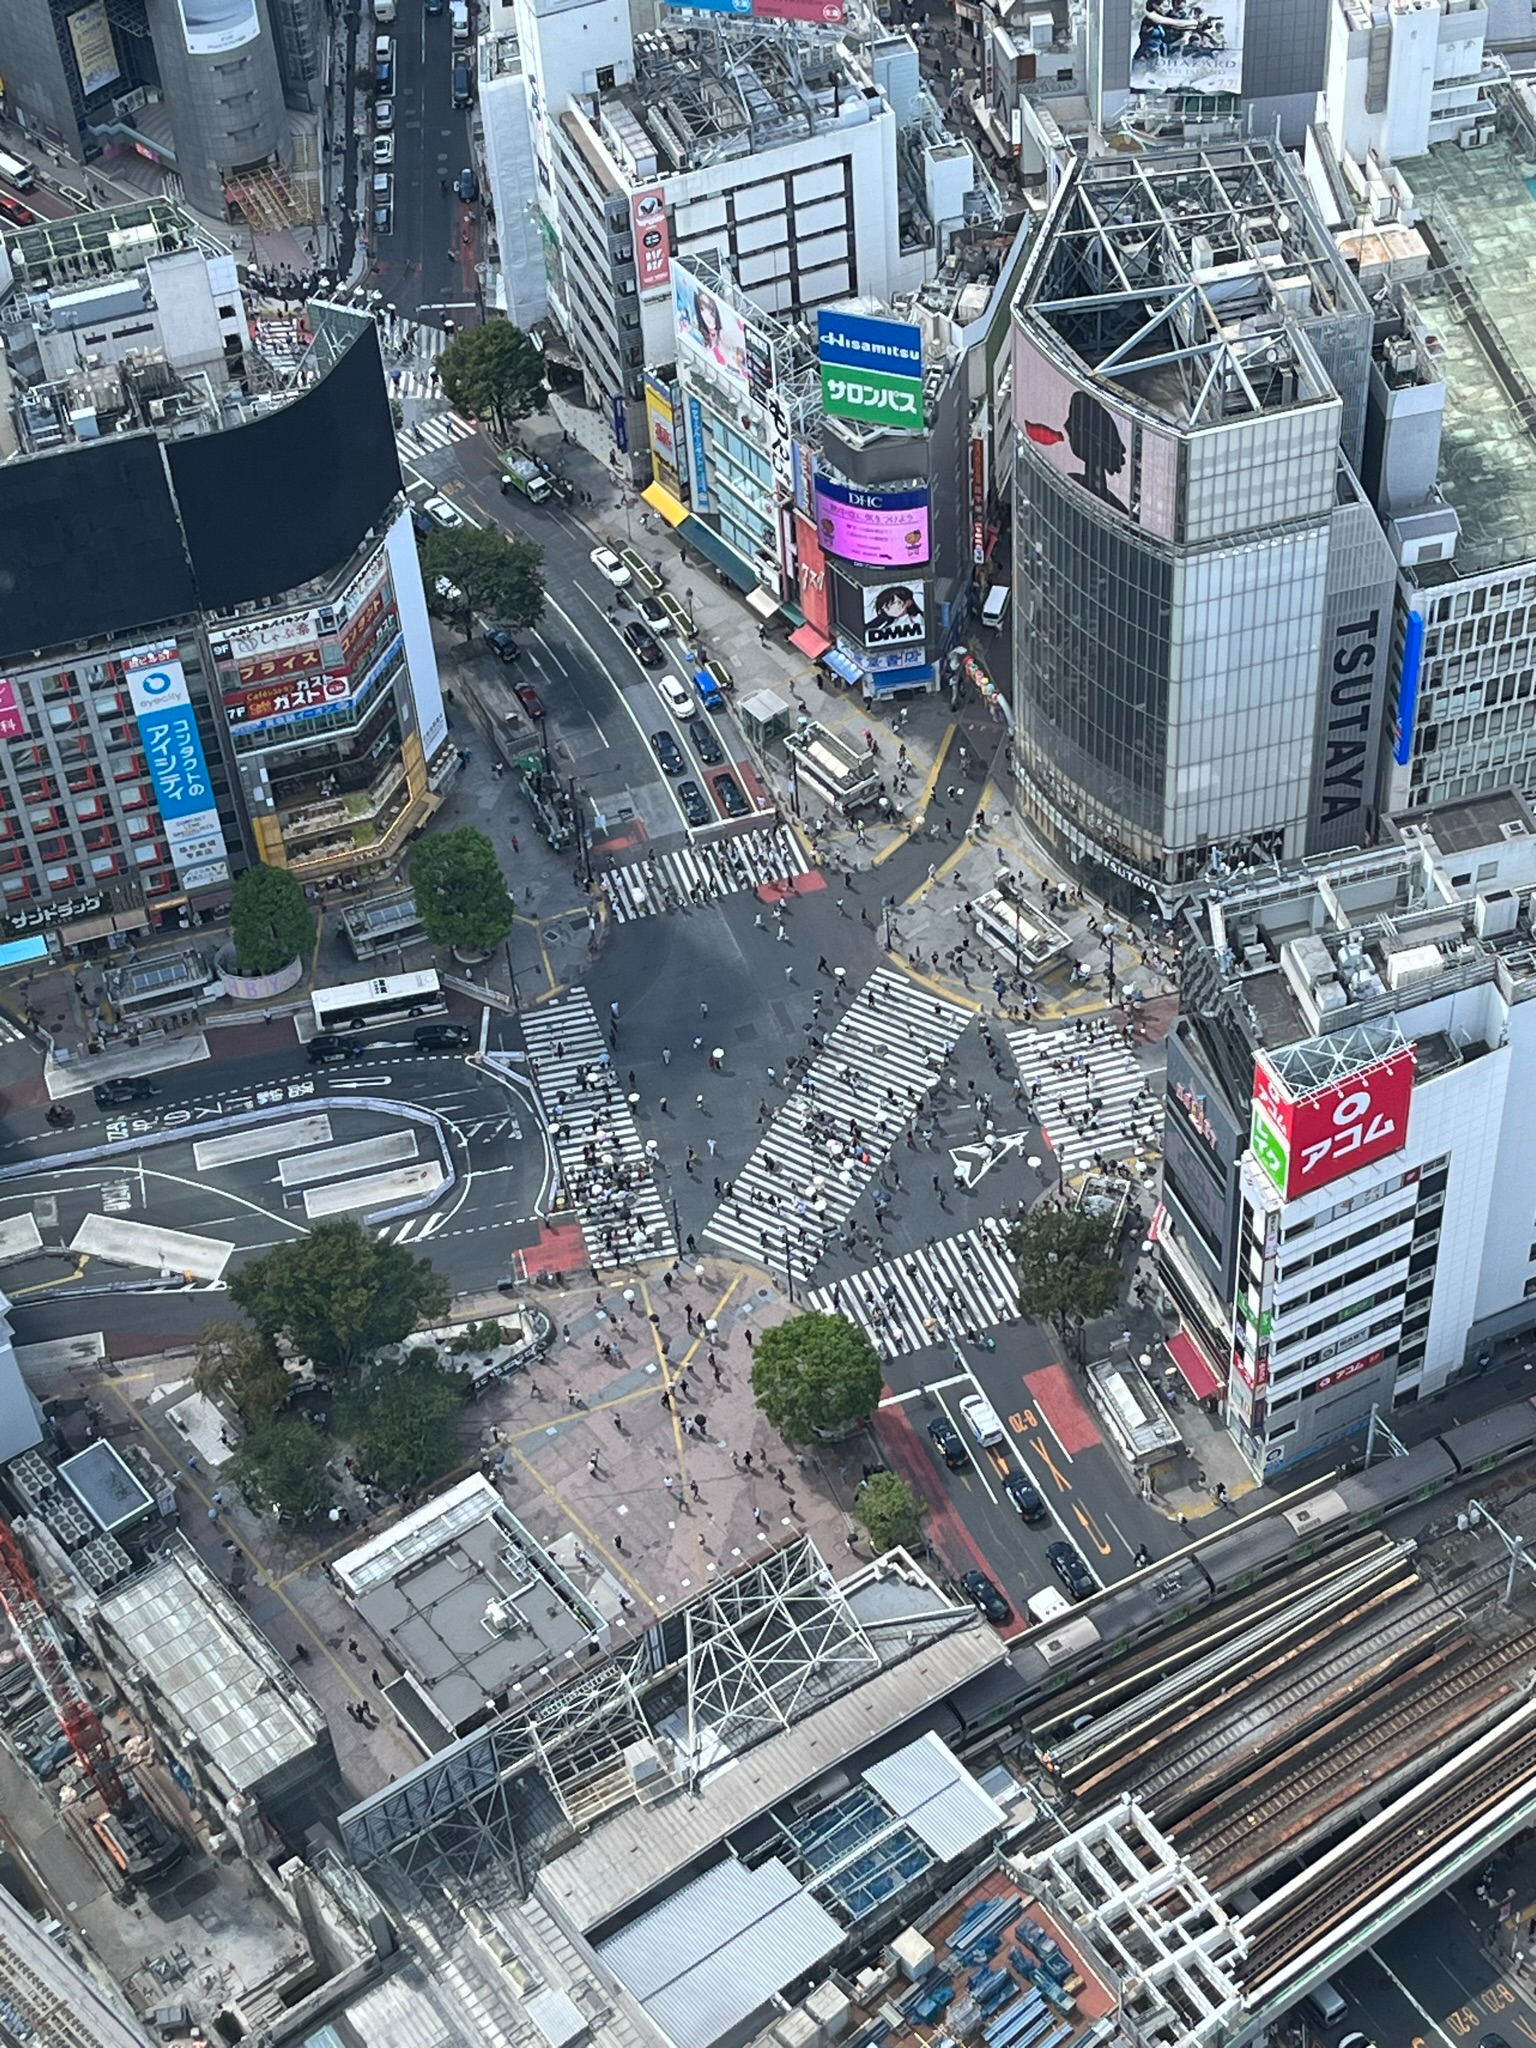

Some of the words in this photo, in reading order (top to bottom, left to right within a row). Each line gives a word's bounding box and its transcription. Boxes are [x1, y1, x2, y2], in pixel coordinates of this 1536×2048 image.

[820, 331, 920, 360] Hisamitsu
[827, 379, 917, 415] サロンパス
[848, 493, 883, 508] DHC
[868, 623, 922, 642] DMM
[213, 643, 229, 656] 9F
[296, 674, 334, 691] ガスト
[140, 691, 182, 708] eyecity
[227, 706, 246, 719] 7F
[273, 690, 321, 711] ガスト
[1320, 609, 1380, 825] TSUTAYA
[146, 724, 184, 801] アイシティ
[173, 719, 205, 796] コンタクトの
[1102, 856, 1158, 896] TSUTAYA
[11, 896, 100, 929] サンドラッグ
[1254, 1113, 1281, 1171] レイク
[1301, 1113, 1395, 1174] アコム
[1335, 1363, 1365, 1380] アコム
[1008, 1409, 1038, 1433] 8-20
[1481, 1983, 1515, 2013] 8-20
[1445, 2006, 1480, 2036] 8-20
